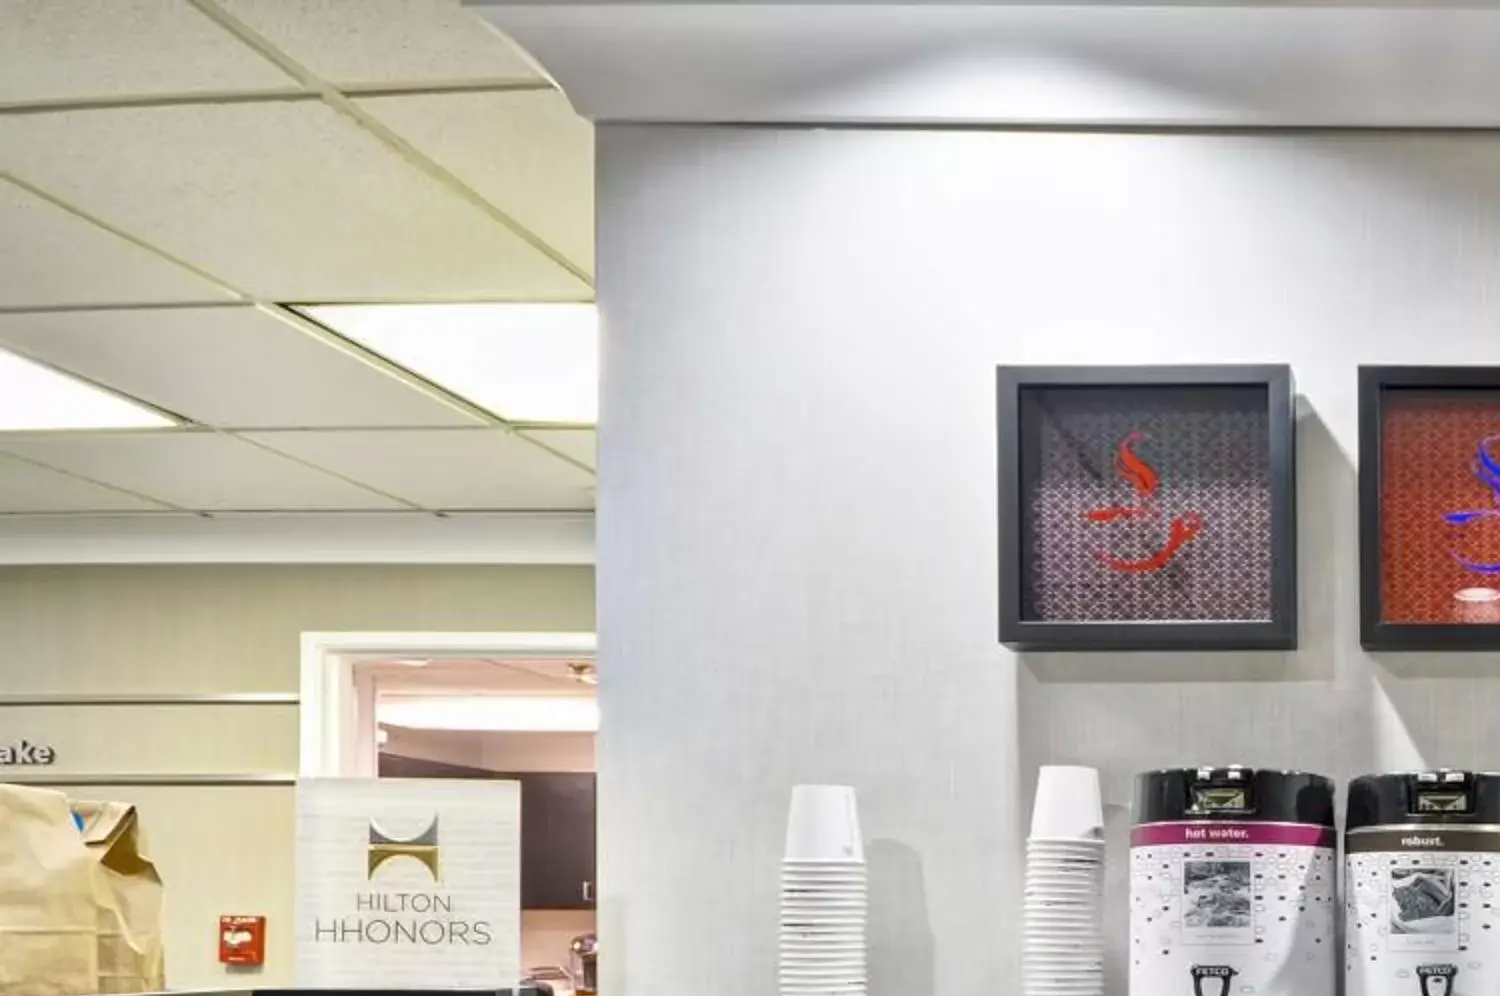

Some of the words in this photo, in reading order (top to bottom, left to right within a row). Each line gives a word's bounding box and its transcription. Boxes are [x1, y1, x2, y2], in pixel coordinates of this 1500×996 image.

[1184, 827, 1206, 840] hot
[356, 893, 452, 912] HILTON
[314, 918, 493, 945] HHONORS
